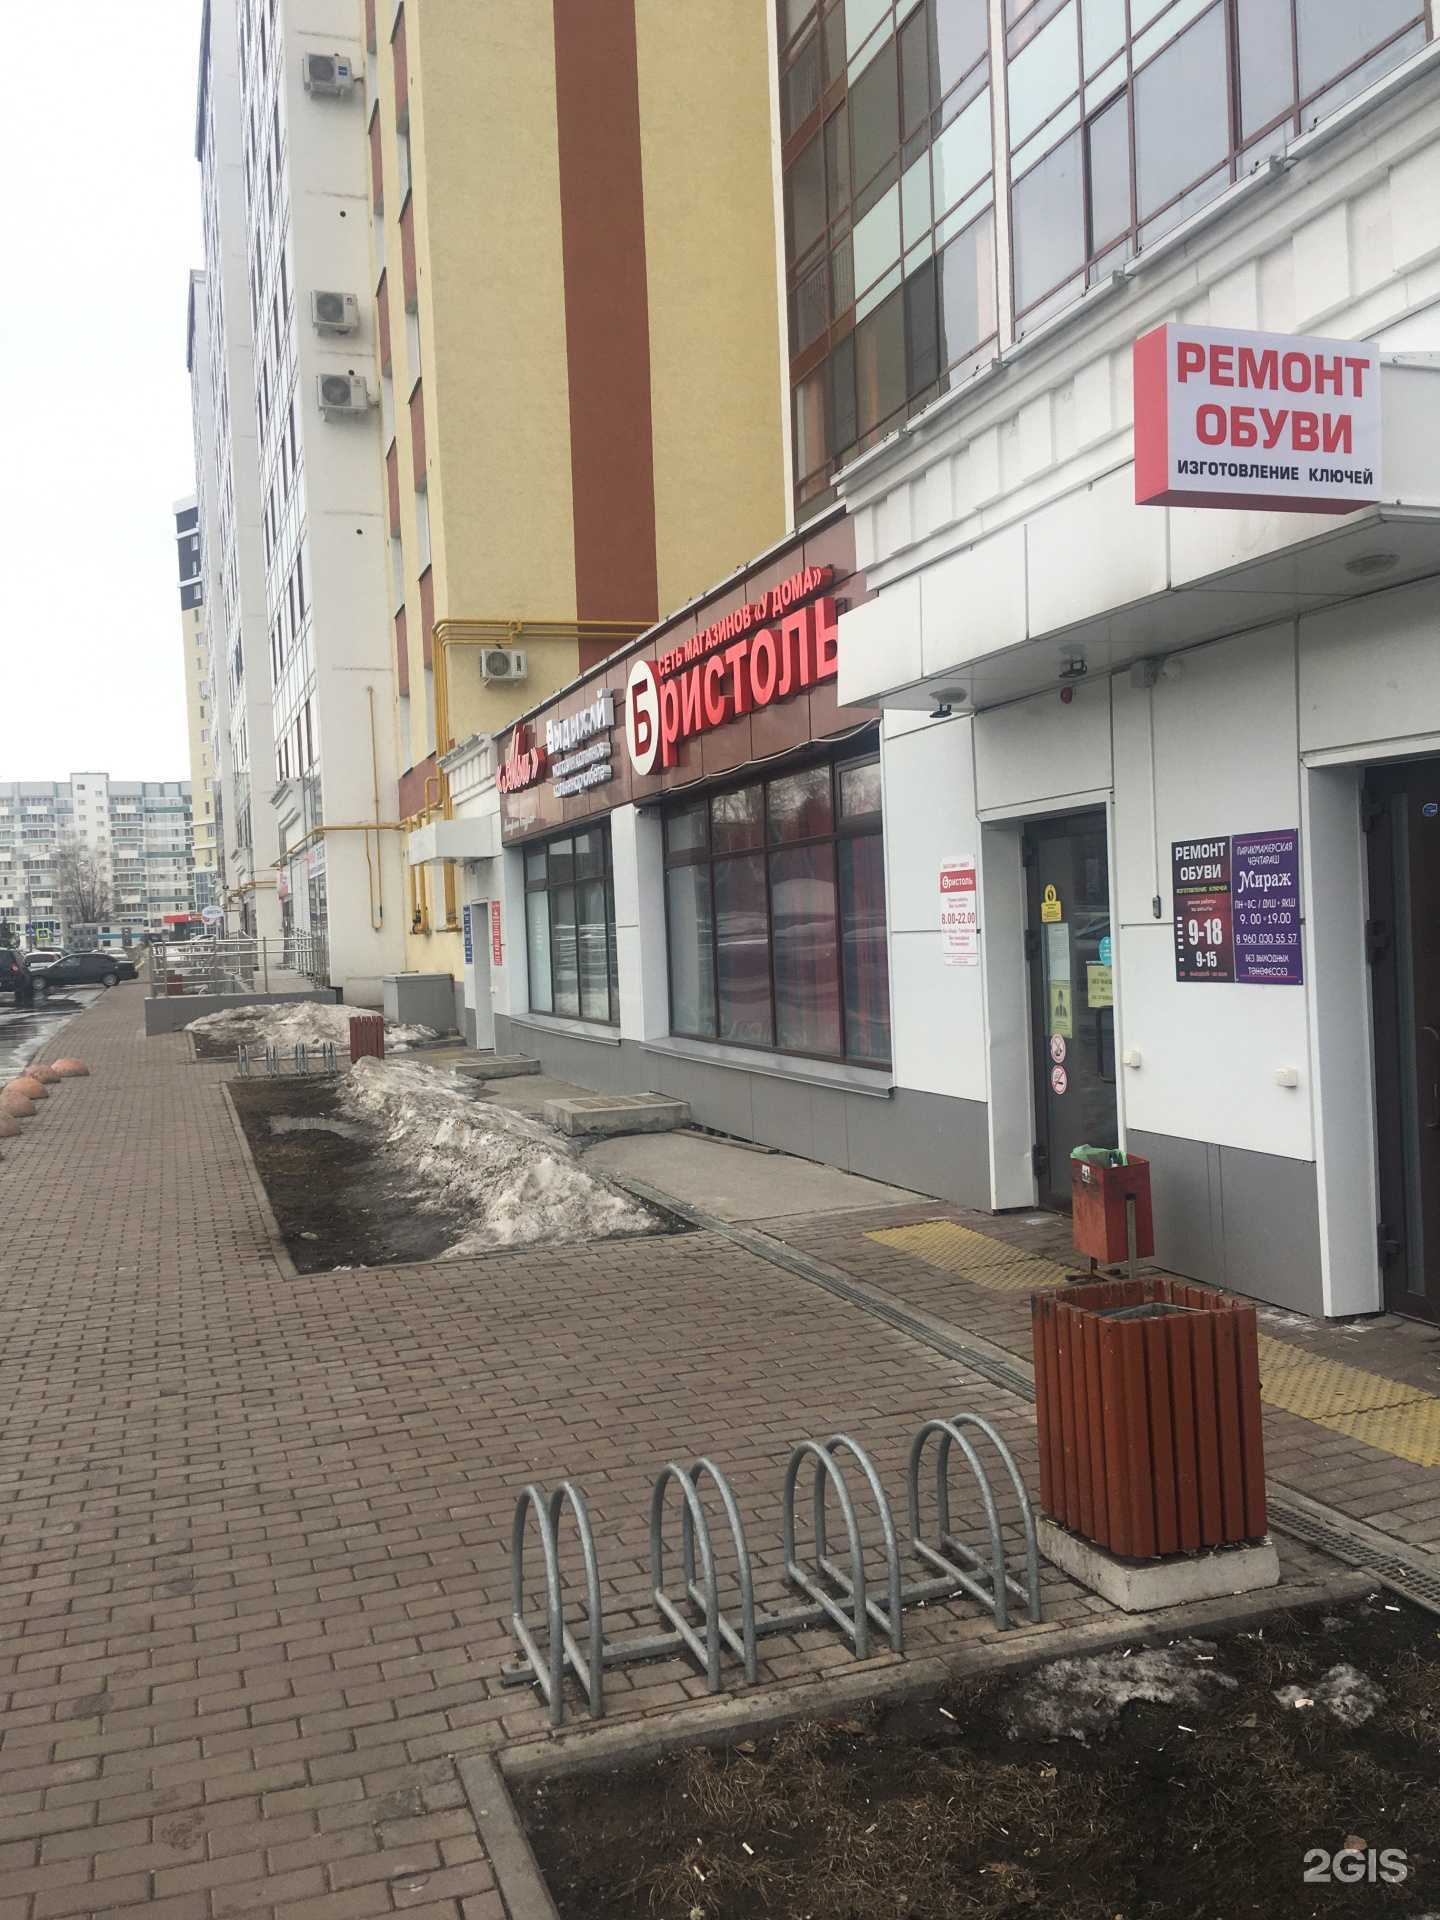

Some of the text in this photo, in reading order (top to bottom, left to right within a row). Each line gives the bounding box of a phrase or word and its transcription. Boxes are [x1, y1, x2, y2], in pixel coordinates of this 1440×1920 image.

[1176, 341, 1370, 398] РЕМОНТ
[1195, 403, 1352, 454] ОБУВИ
[1177, 459, 1373, 486] ИЗГОТОВЛЕНИЕ КЛЮЧЕЙ
[658, 647, 683, 676] СЕТЬ
[684, 606, 751, 662] МАГАЗИНОВ
[772, 567, 822, 617] ДОМА»
[1175, 842, 1226, 861] РЕМОНТ
[1236, 841, 1293, 856] ПАРИКМАХЕРСКАЯ
[1180, 863, 1222, 881] ОБУВИ
[1237, 870, 1292, 893] Мираж
[941, 911, 976, 924] 8.00-22.00
[1188, 917, 1223, 945] 9-18
[1196, 951, 1217, 967] 9-15
